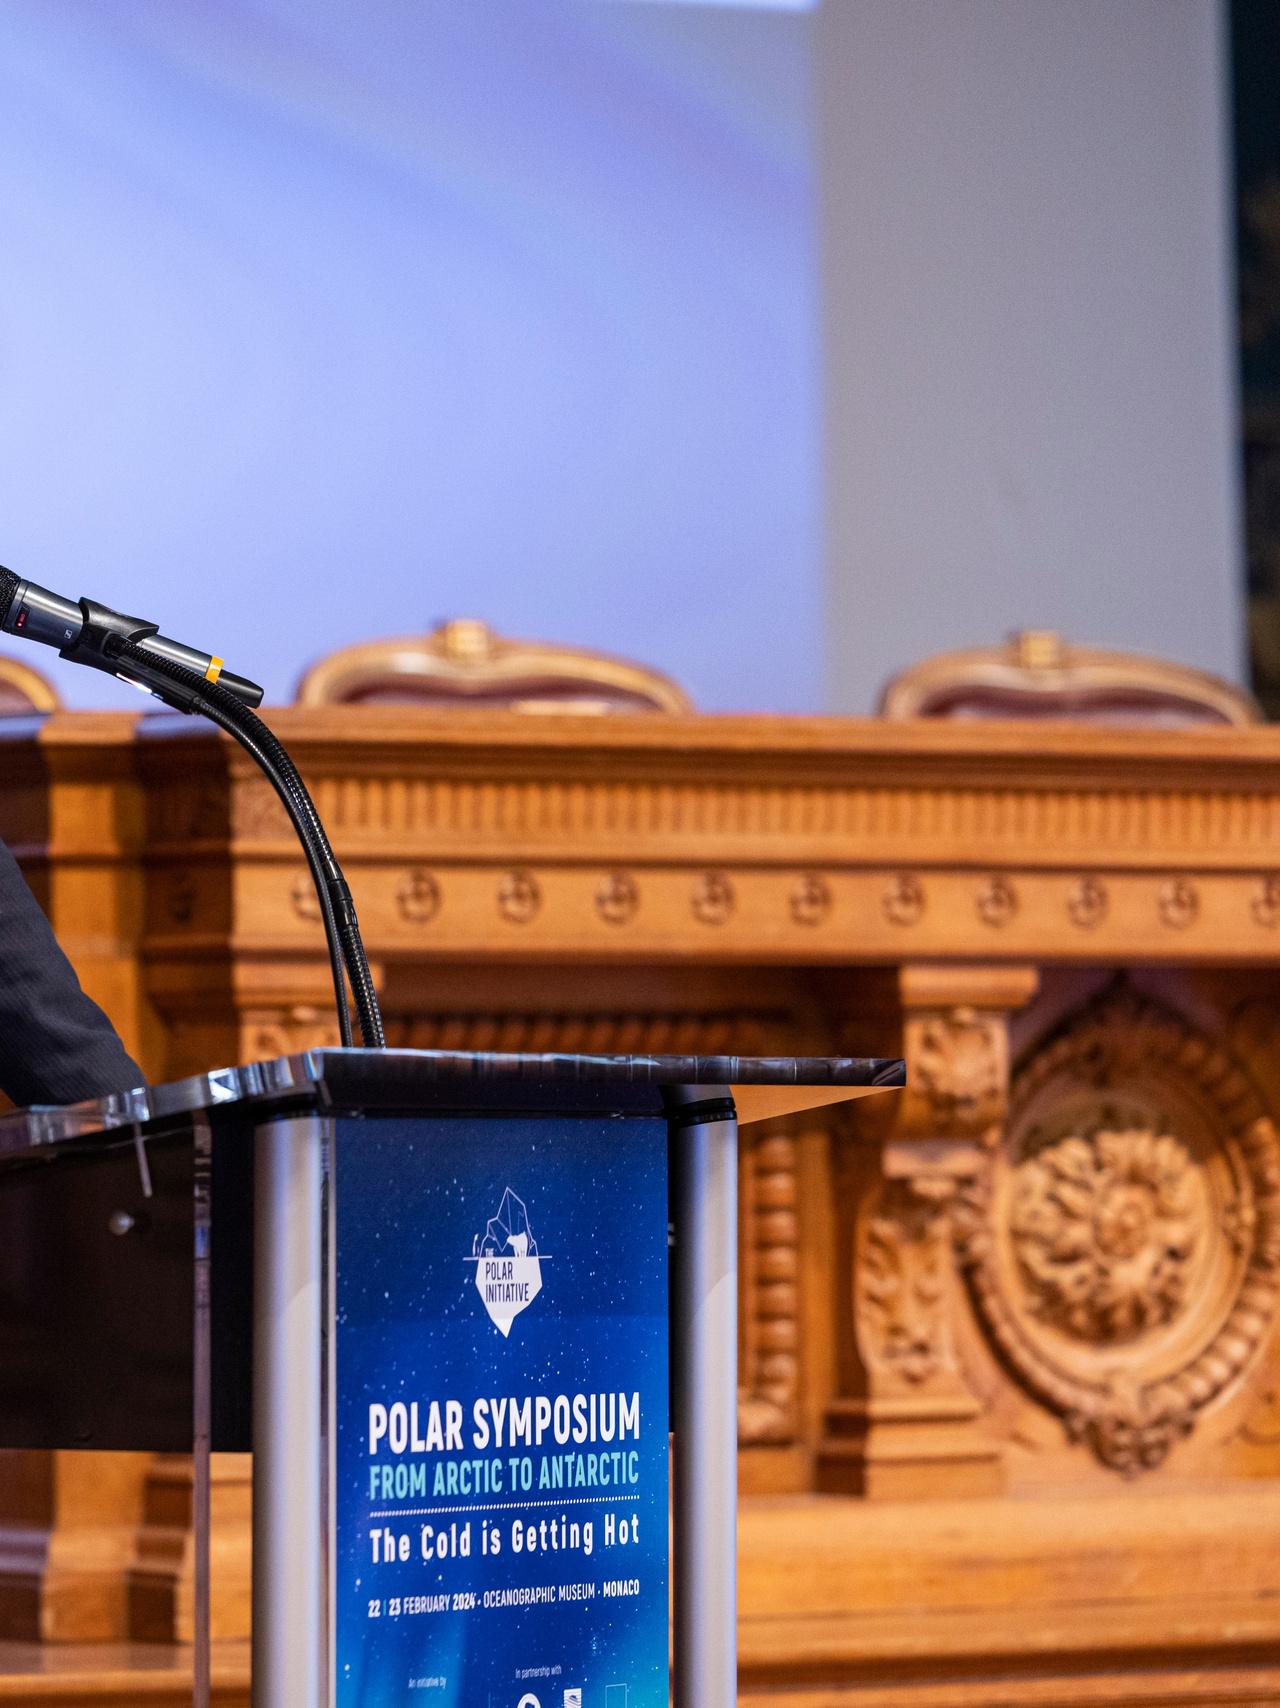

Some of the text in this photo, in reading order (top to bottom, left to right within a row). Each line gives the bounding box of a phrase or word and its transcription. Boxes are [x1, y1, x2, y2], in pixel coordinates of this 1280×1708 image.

[486, 1261, 513, 1281] POLAR
[486, 1282, 529, 1303] INITIATIVE
[369, 1391, 639, 1456] POLAR SYMPOSIUM
[369, 1450, 639, 1501] FROM ARCTIC TO ANTARCTIC
[369, 1513, 639, 1564] The Cold is Getting Hot
[367, 1599, 381, 1617] 22
[388, 1597, 402, 1616] 23
[403, 1594, 450, 1615] FEBRUARY
[452, 1592, 475, 1612] 2024
[483, 1585, 556, 1609] OCEANOGRAPHIC
[558, 1582, 595, 1601] MUSEUM
[603, 1579, 640, 1597] MONACO
[408, 1676, 447, 1689] An initiative by
[515, 1664, 562, 1680] In partnership with
